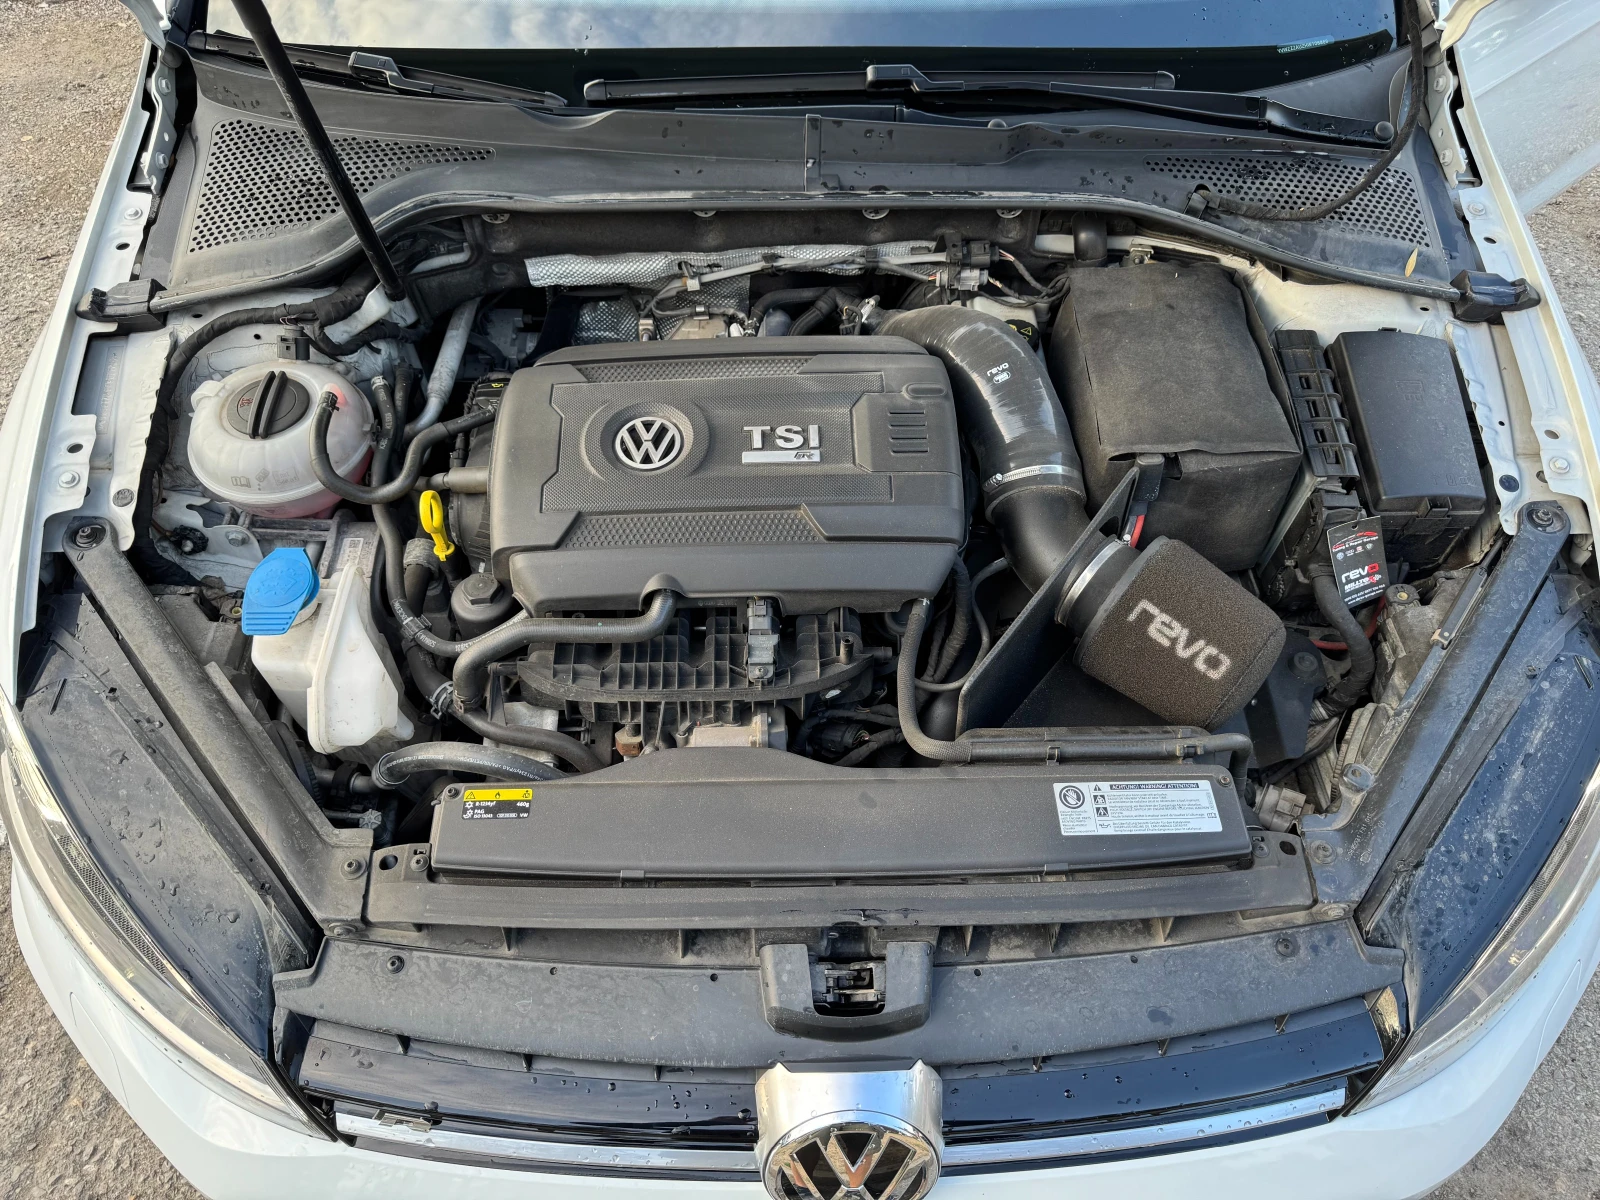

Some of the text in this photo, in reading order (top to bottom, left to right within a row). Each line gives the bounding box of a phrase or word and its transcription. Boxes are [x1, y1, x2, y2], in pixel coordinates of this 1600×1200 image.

[987, 363, 1009, 376] revo
[743, 424, 820, 449] TSI
[1341, 563, 1379, 583] revo
[1127, 600, 1231, 679] revo
